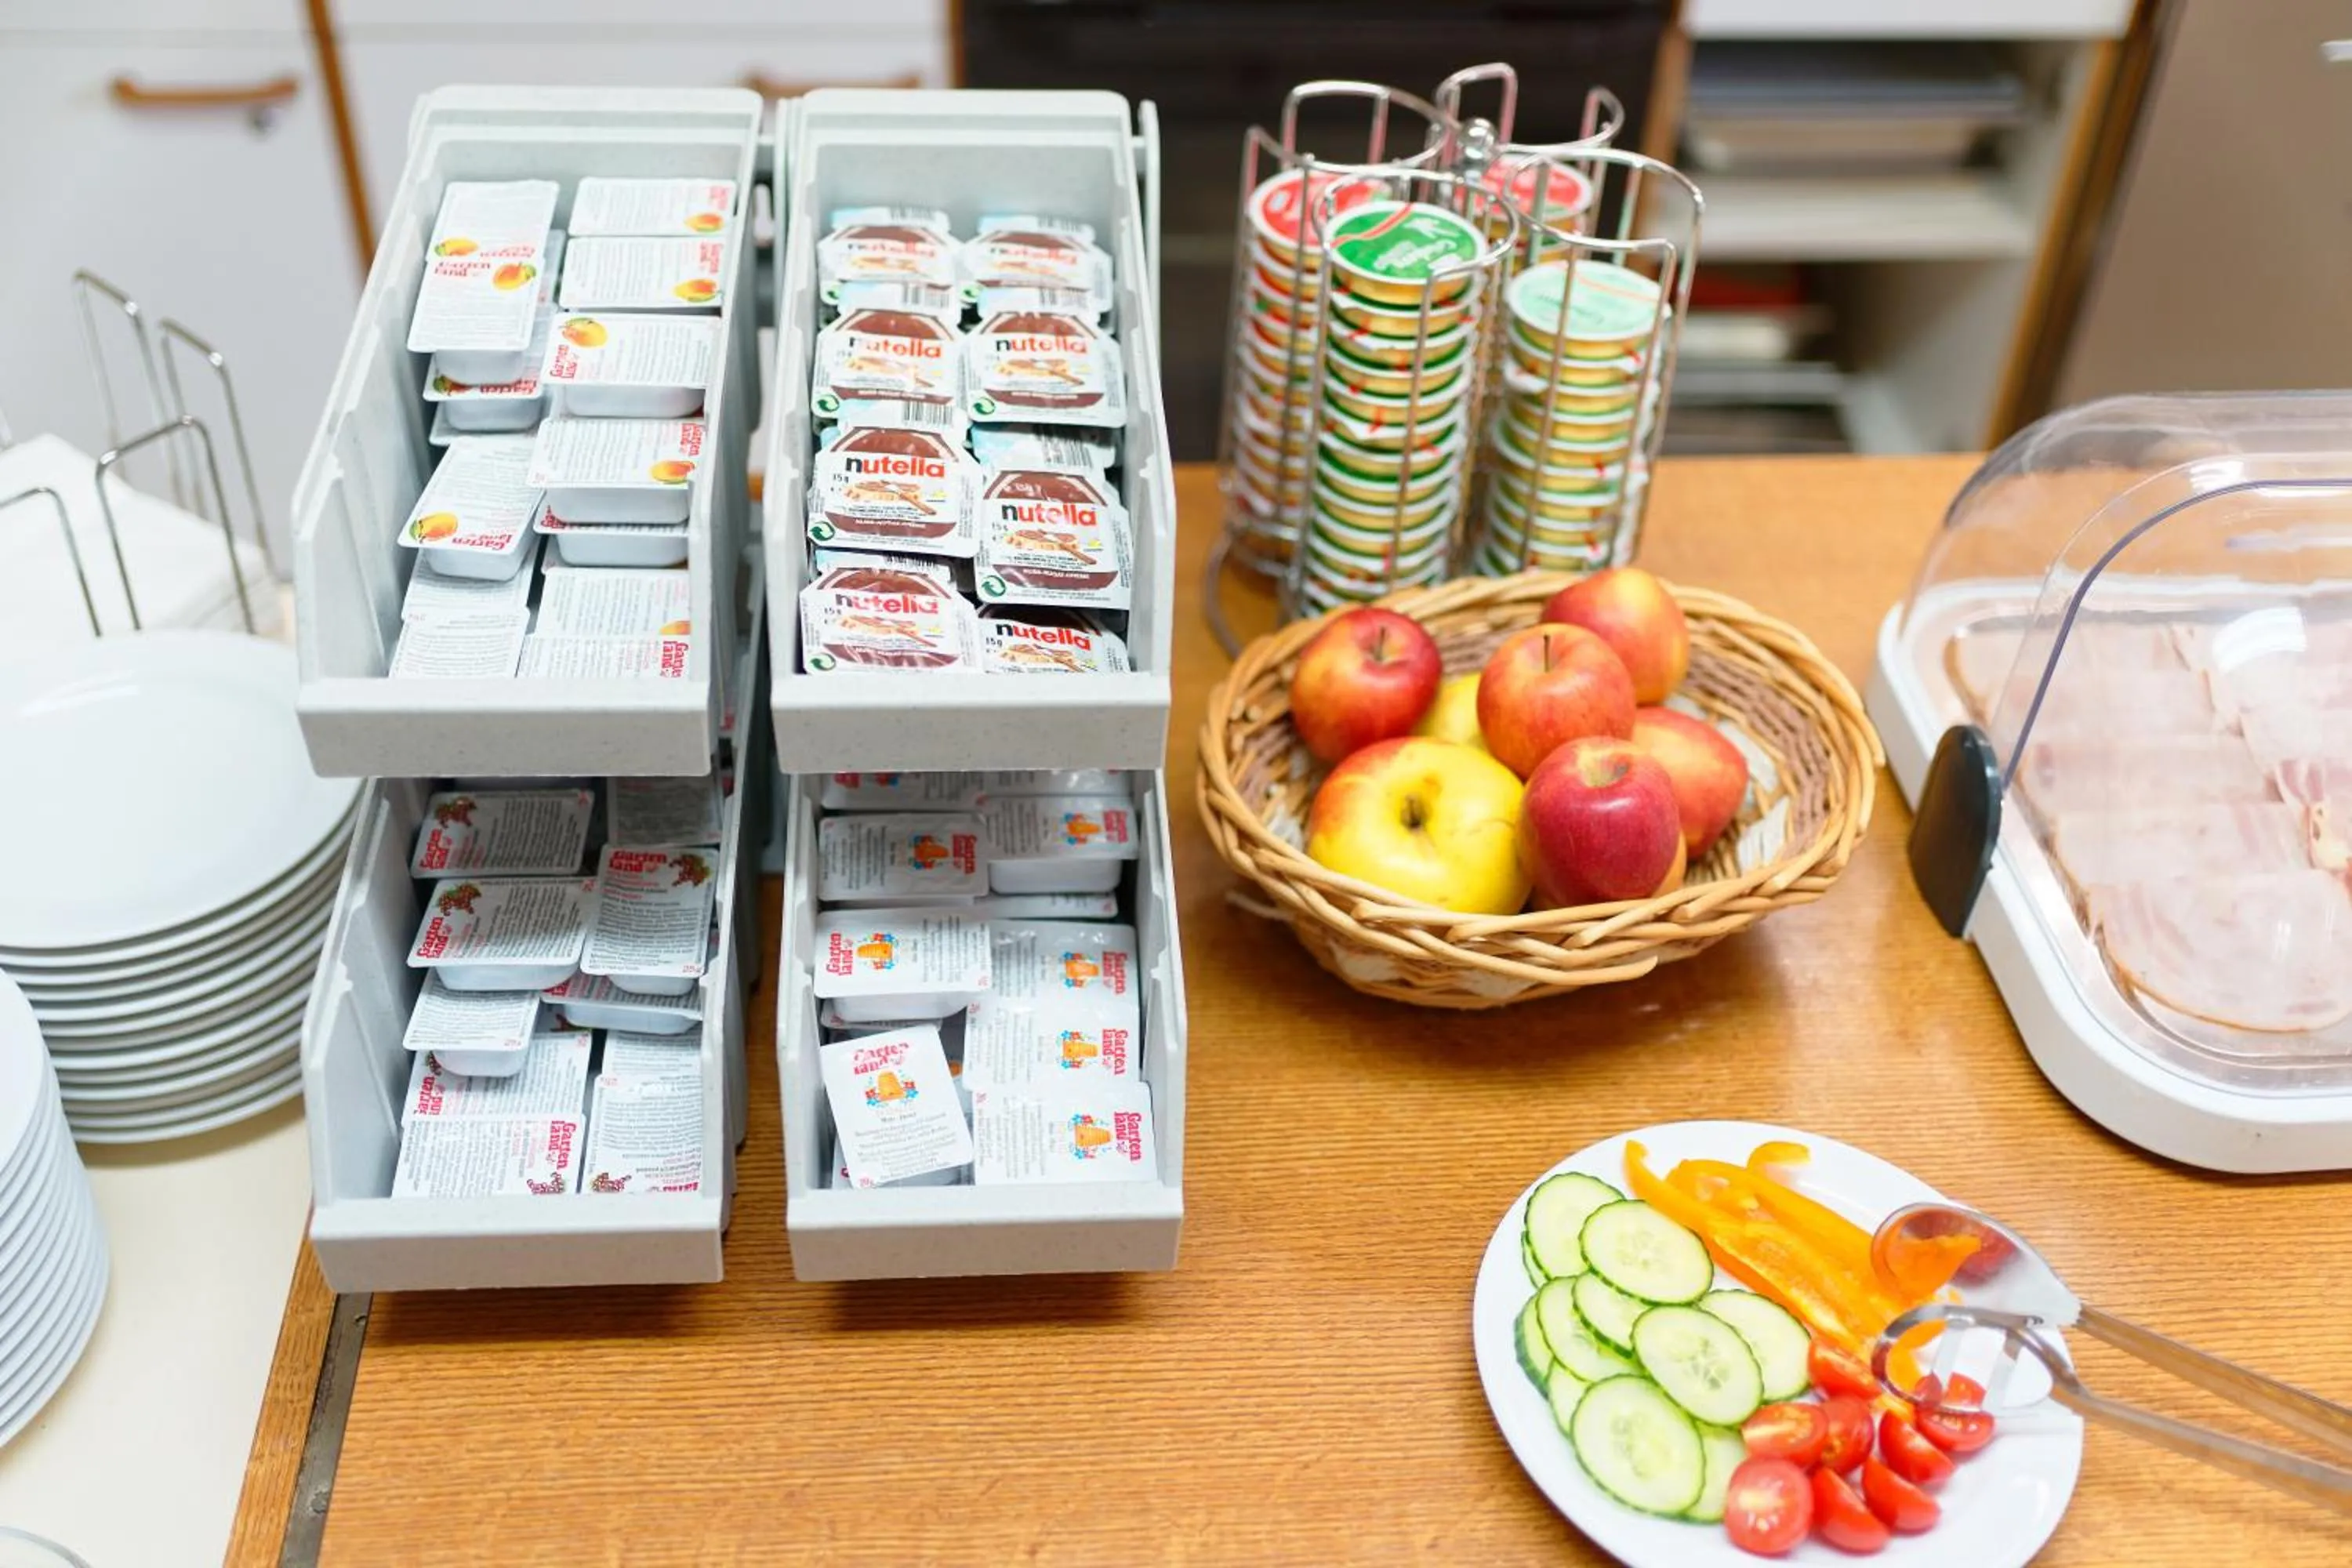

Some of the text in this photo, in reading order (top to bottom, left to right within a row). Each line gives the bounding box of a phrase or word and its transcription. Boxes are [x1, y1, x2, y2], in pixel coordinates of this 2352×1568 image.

[996, 336, 1087, 354] nutella
[845, 456, 945, 477] nutella
[1002, 503, 1097, 526] nutella
[836, 593, 939, 615] nutella
[996, 623, 1091, 651] nutella
[672, 642, 688, 678] Garte
[417, 917, 444, 956] Garten
[826, 933, 842, 972] Garten
[838, 949, 853, 975] land
[1113, 952, 1127, 995] Garten
[1102, 1028, 1116, 1055] land
[1114, 1029, 1129, 1076] Garten
[414, 1077, 434, 1115] arten
[549, 1120, 564, 1151] land
[1114, 1111, 1130, 1140] land
[1127, 1112, 1142, 1161] Garten
[556, 1122, 576, 1169] Garten
